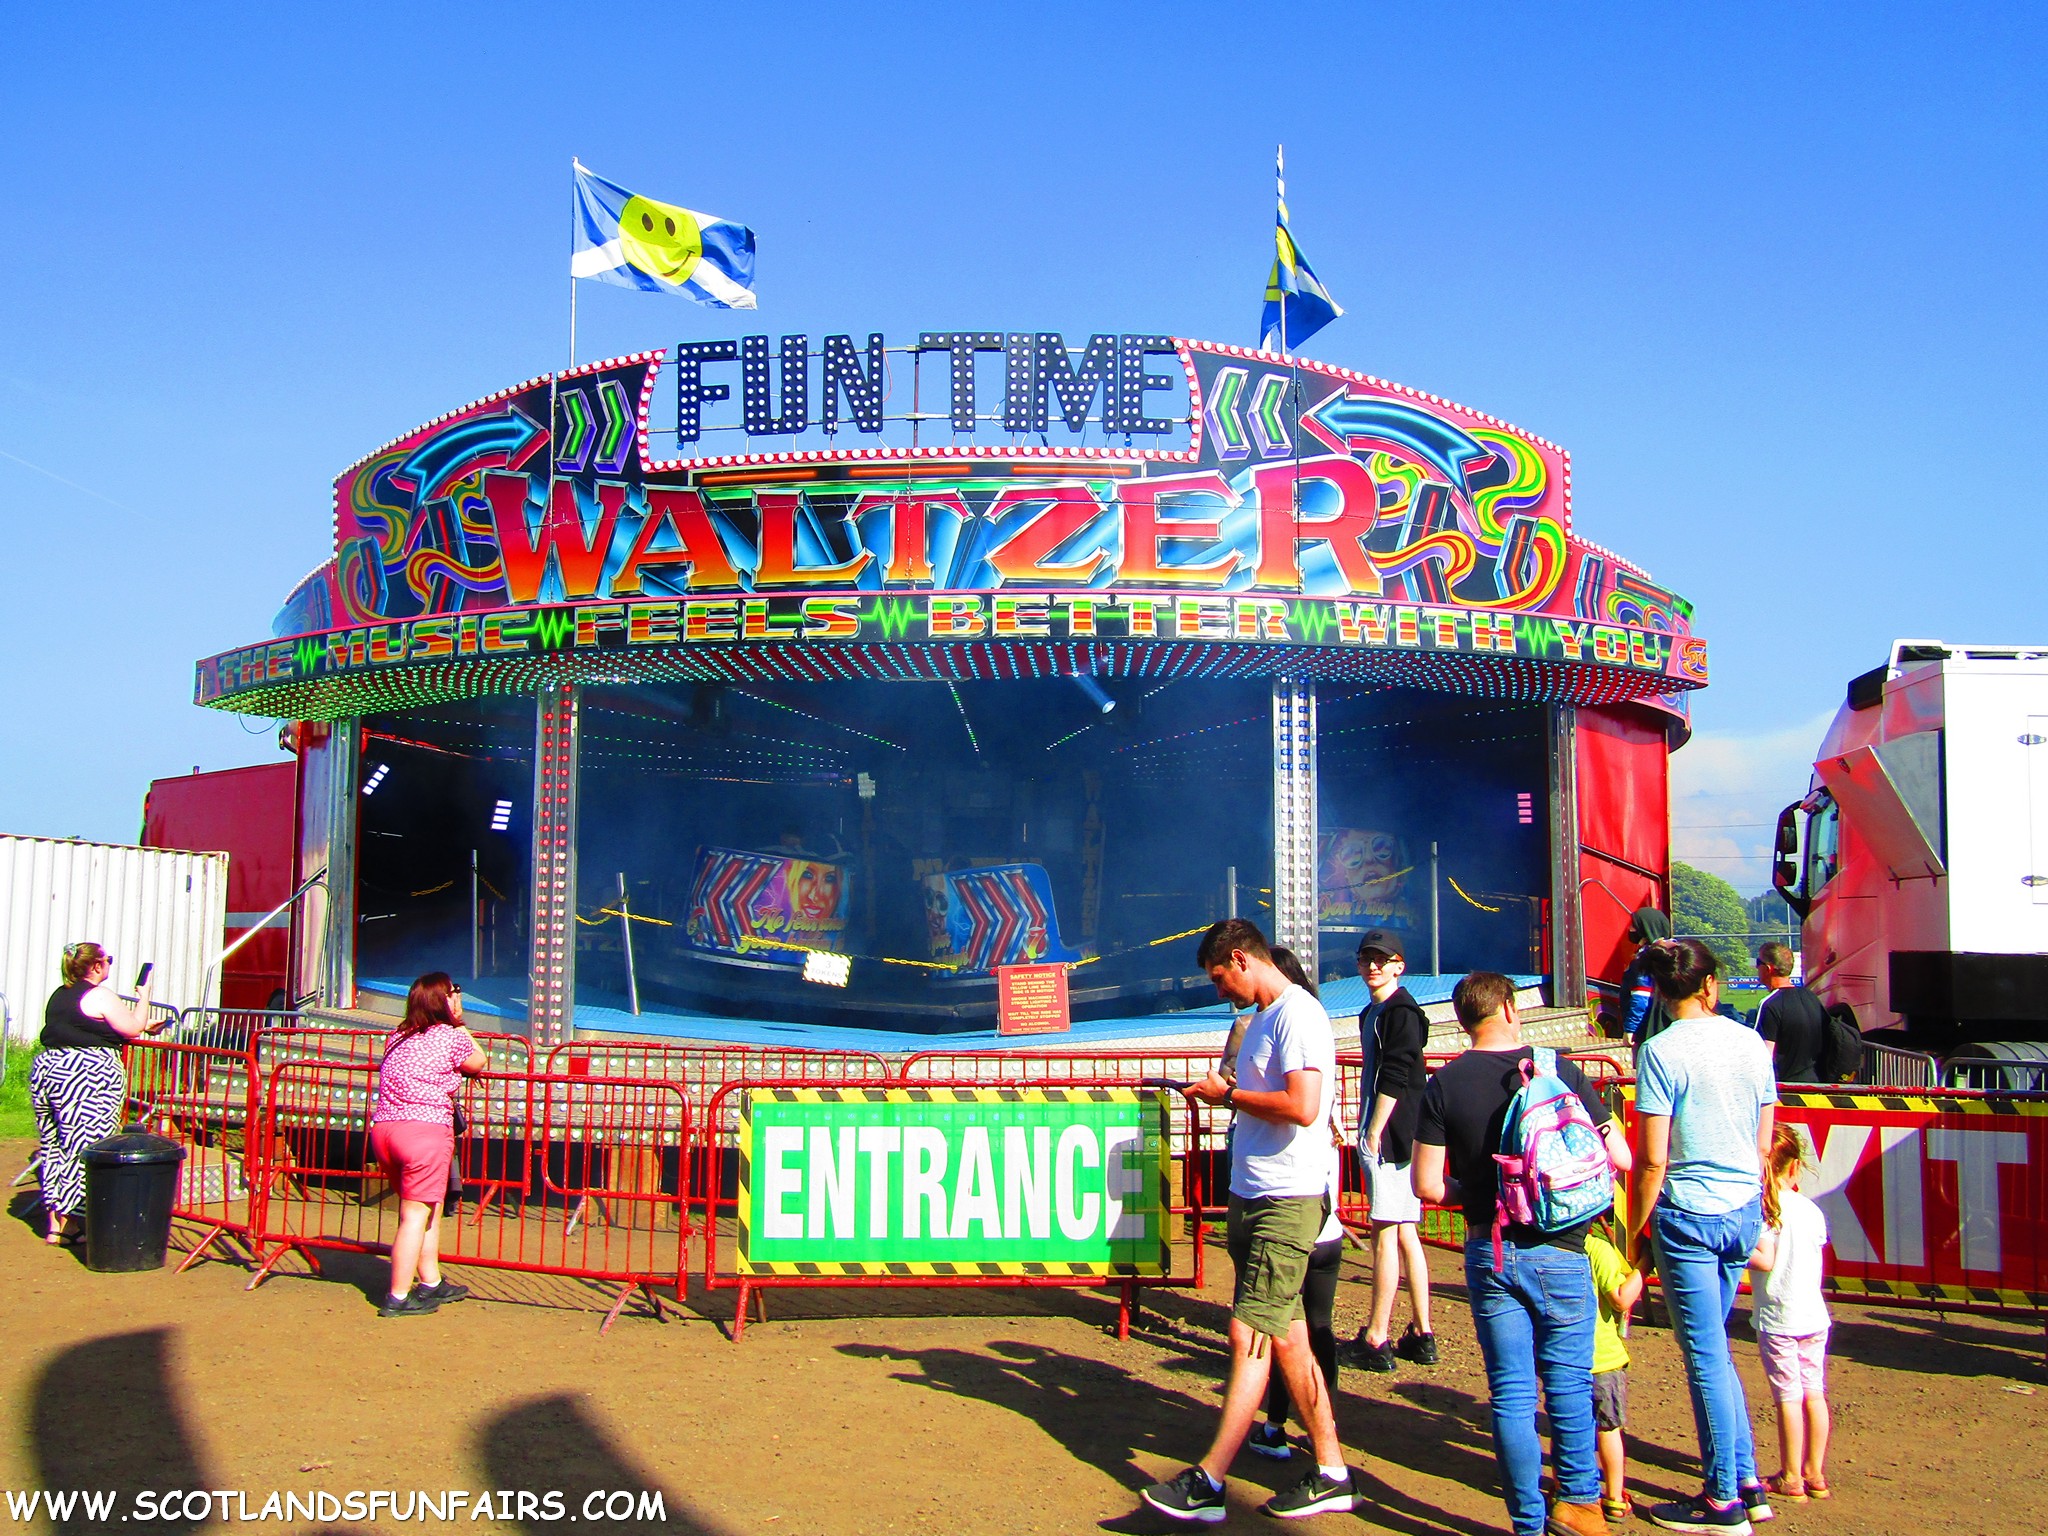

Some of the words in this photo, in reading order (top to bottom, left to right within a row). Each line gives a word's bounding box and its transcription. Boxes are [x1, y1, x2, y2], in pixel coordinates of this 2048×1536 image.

[677, 333, 884, 442] FUN
[918, 332, 1175, 433] TIME
[480, 453, 1384, 607] WALTZER
[218, 645, 297, 691] THE
[326, 609, 532, 672] MUSIC
[573, 597, 862, 648] FEELS
[928, 593, 1291, 643] BETTER
[1334, 600, 1518, 653] WITH
[1550, 619, 1663, 671] YOU
[763, 1124, 1145, 1241] ENTRANCE
[1779, 1121, 2029, 1273] XIT
